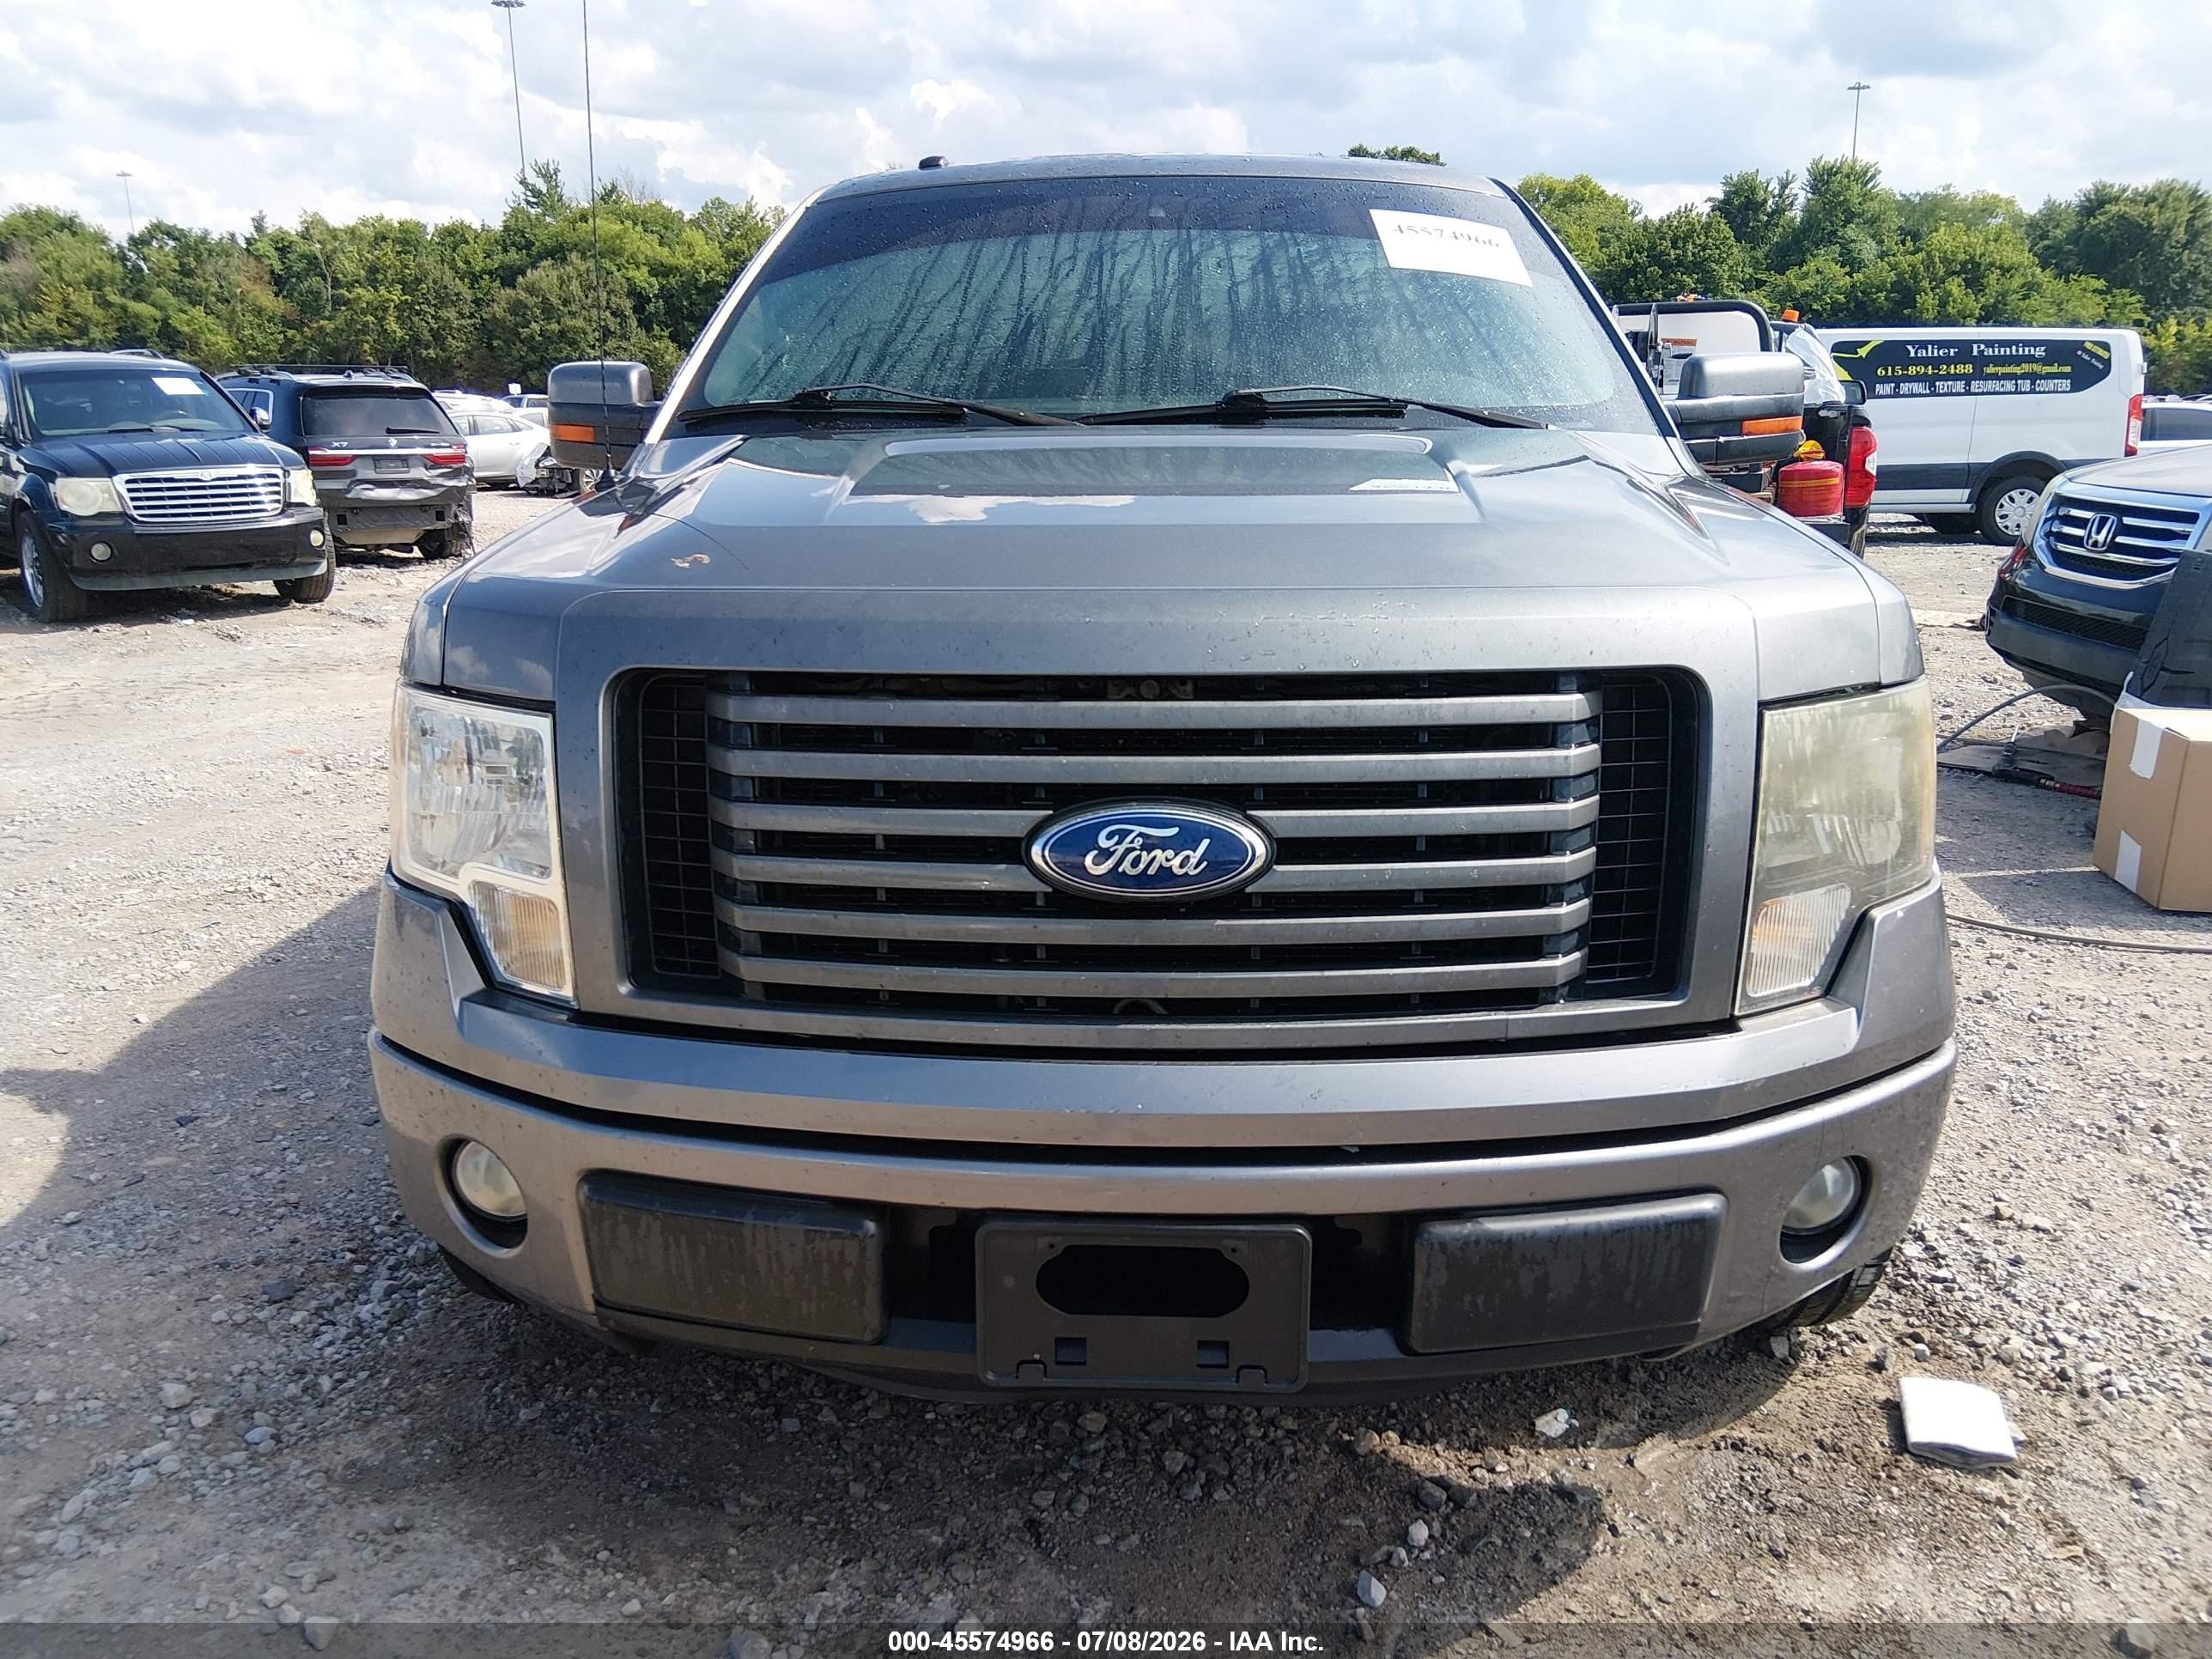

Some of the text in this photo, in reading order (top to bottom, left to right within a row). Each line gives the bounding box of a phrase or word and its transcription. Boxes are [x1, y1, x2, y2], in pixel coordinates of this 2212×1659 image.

[1905, 343, 2047, 358] Yalier Painting
[1876, 364, 1973, 376] 615-894-2488
[1875, 383, 1895, 395] PAINT
[1899, 382, 1929, 395] DRYWALL
[1936, 380, 1965, 393] TEXTURE
[1971, 380, 2015, 392] RESURFACING
[2017, 380, 2031, 392] TUB
[2035, 380, 2071, 392] COUNTERS
[1085, 823, 1211, 876] Ford
